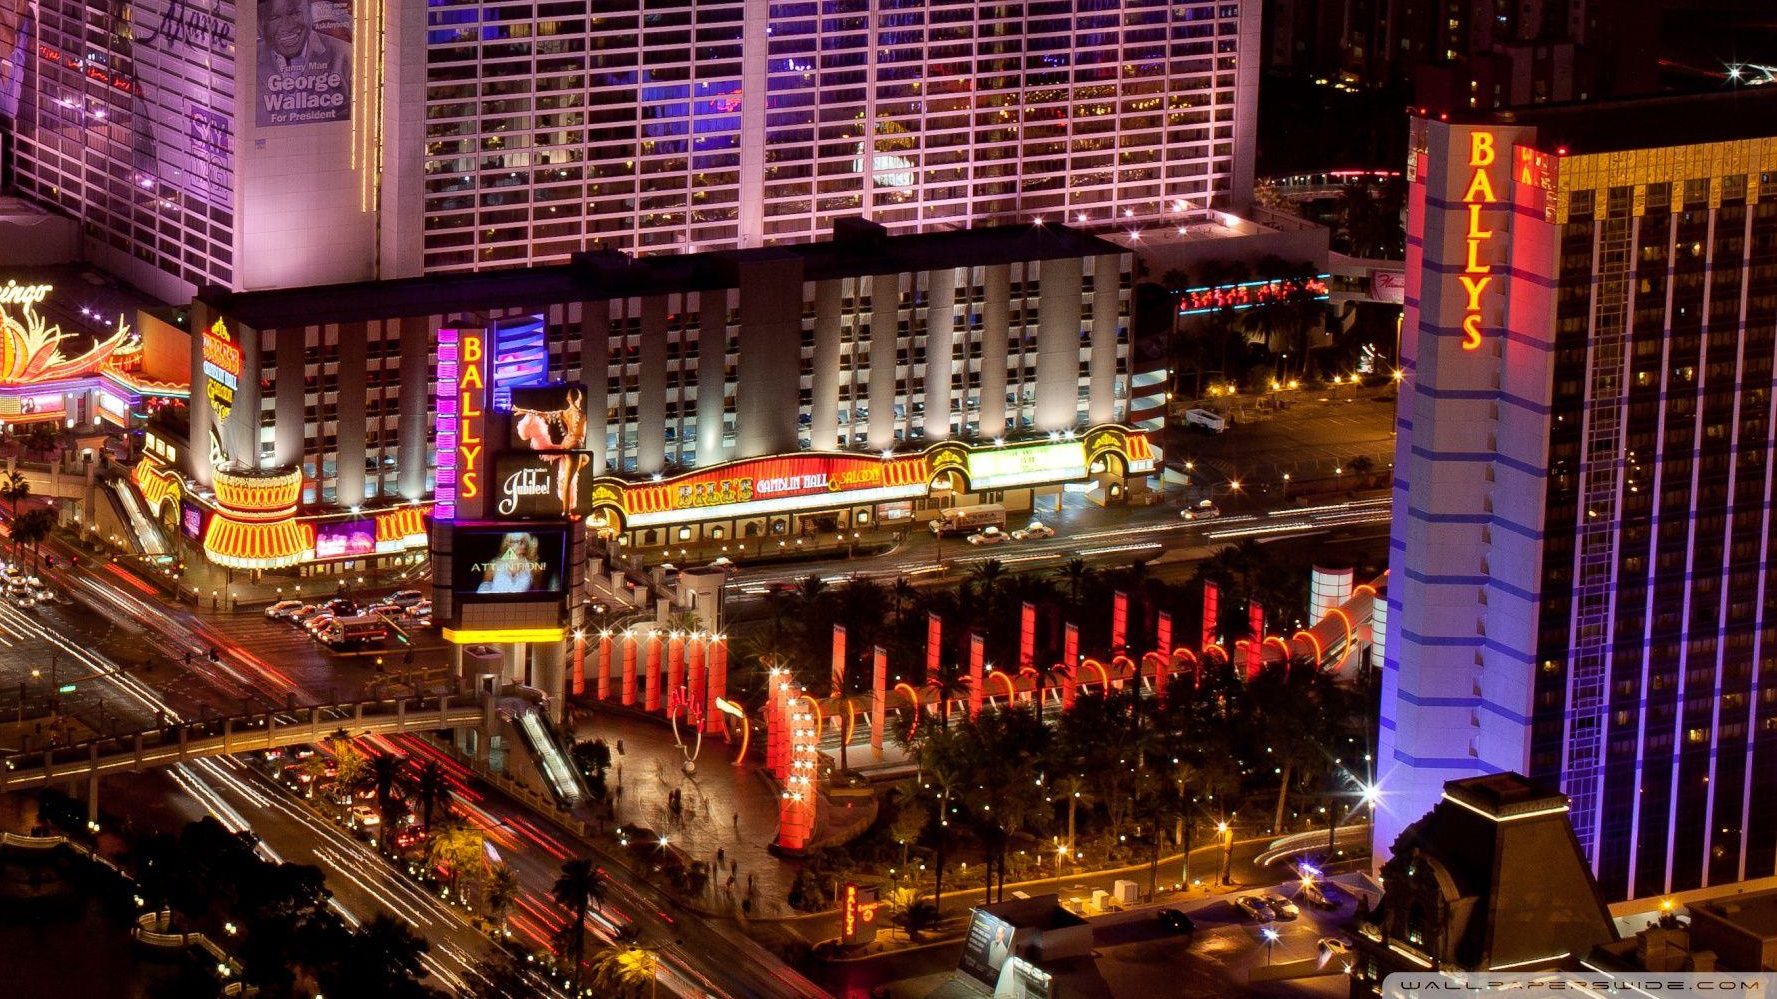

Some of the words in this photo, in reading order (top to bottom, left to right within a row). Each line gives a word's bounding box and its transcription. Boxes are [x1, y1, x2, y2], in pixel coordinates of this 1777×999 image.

[279, 64, 305, 74] Funny
[308, 62, 328, 71] Man
[267, 72, 341, 92] George
[263, 91, 344, 111] Wallace
[270, 113, 288, 123] For
[289, 109, 336, 121] President
[1460, 131, 1496, 351] BALLYS
[459, 336, 484, 499] BALLYS
[804, 473, 829, 489] HALL
[828, 477, 840, 491] &
[840, 468, 880, 485] SALOON
[498, 469, 551, 515] Jubilee!
[471, 562, 547, 572] ATTENTION!
